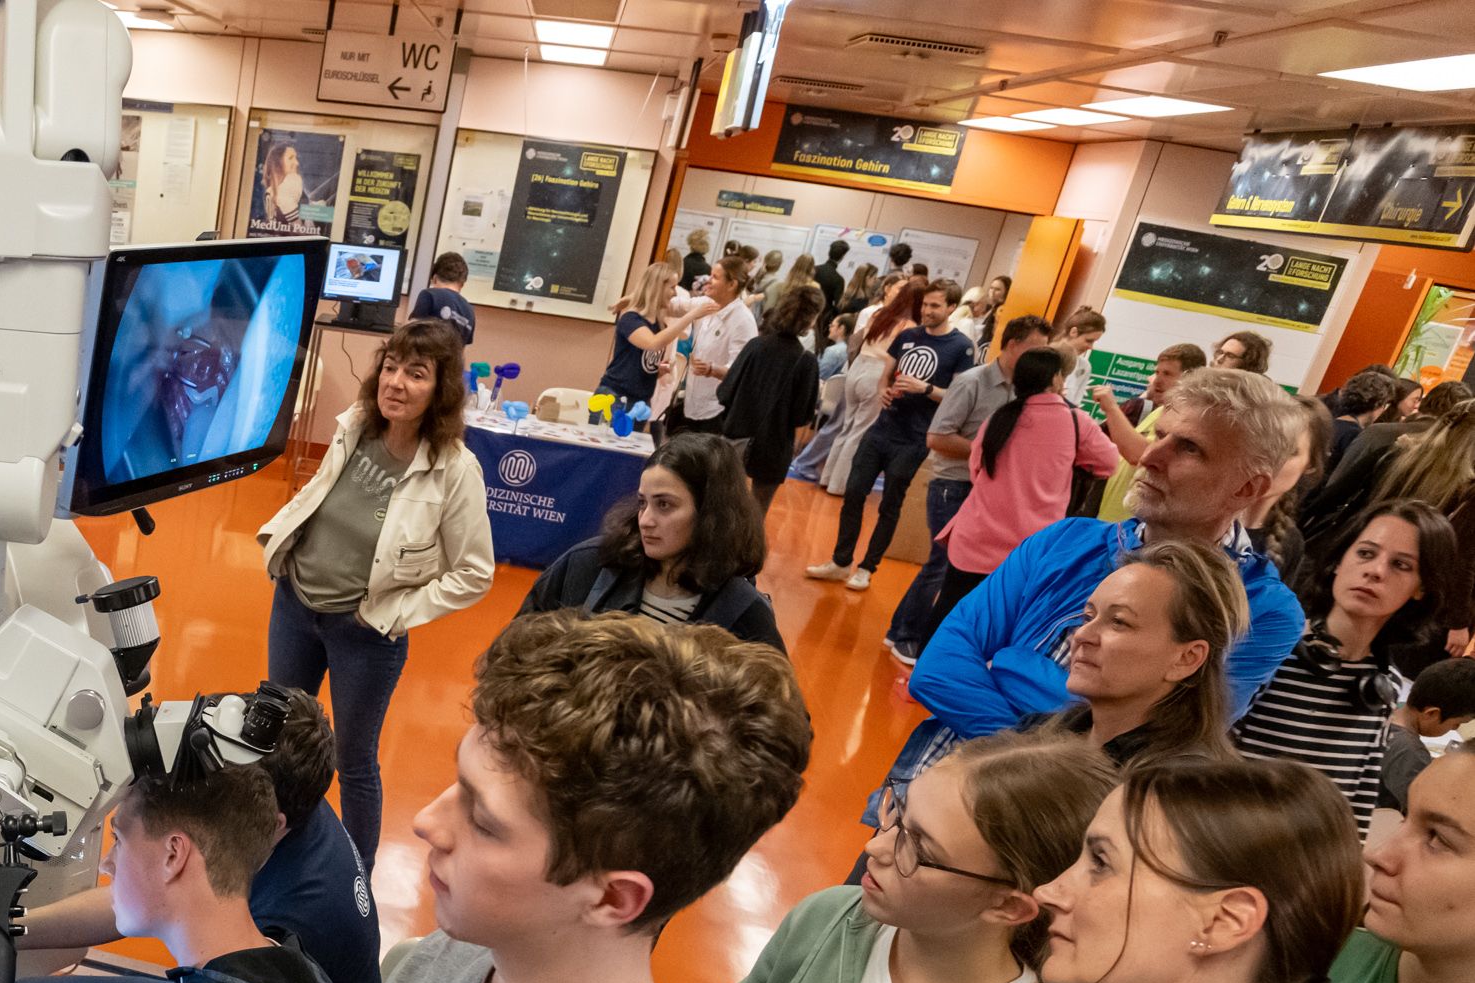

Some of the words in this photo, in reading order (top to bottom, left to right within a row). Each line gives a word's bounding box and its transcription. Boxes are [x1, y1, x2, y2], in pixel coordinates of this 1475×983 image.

[340, 51, 356, 61] NUR
[357, 52, 370, 62] MIT
[402, 42, 441, 71] WC
[323, 69, 380, 84] EUROSCHLÜSSEL
[793, 150, 853, 169] Faszination
[855, 158, 891, 174] Gehirn
[250, 218, 292, 232] MedUni
[293, 221, 322, 236] Point
[1291, 260, 1312, 271] LANGE
[1311, 264, 1333, 274] NACHT
[1293, 269, 1329, 282] FORSCHUNG
[1116, 357, 1145, 371] Ausgang
[487, 500, 530, 517] RSITÄT
[533, 507, 566, 524] WIEN
